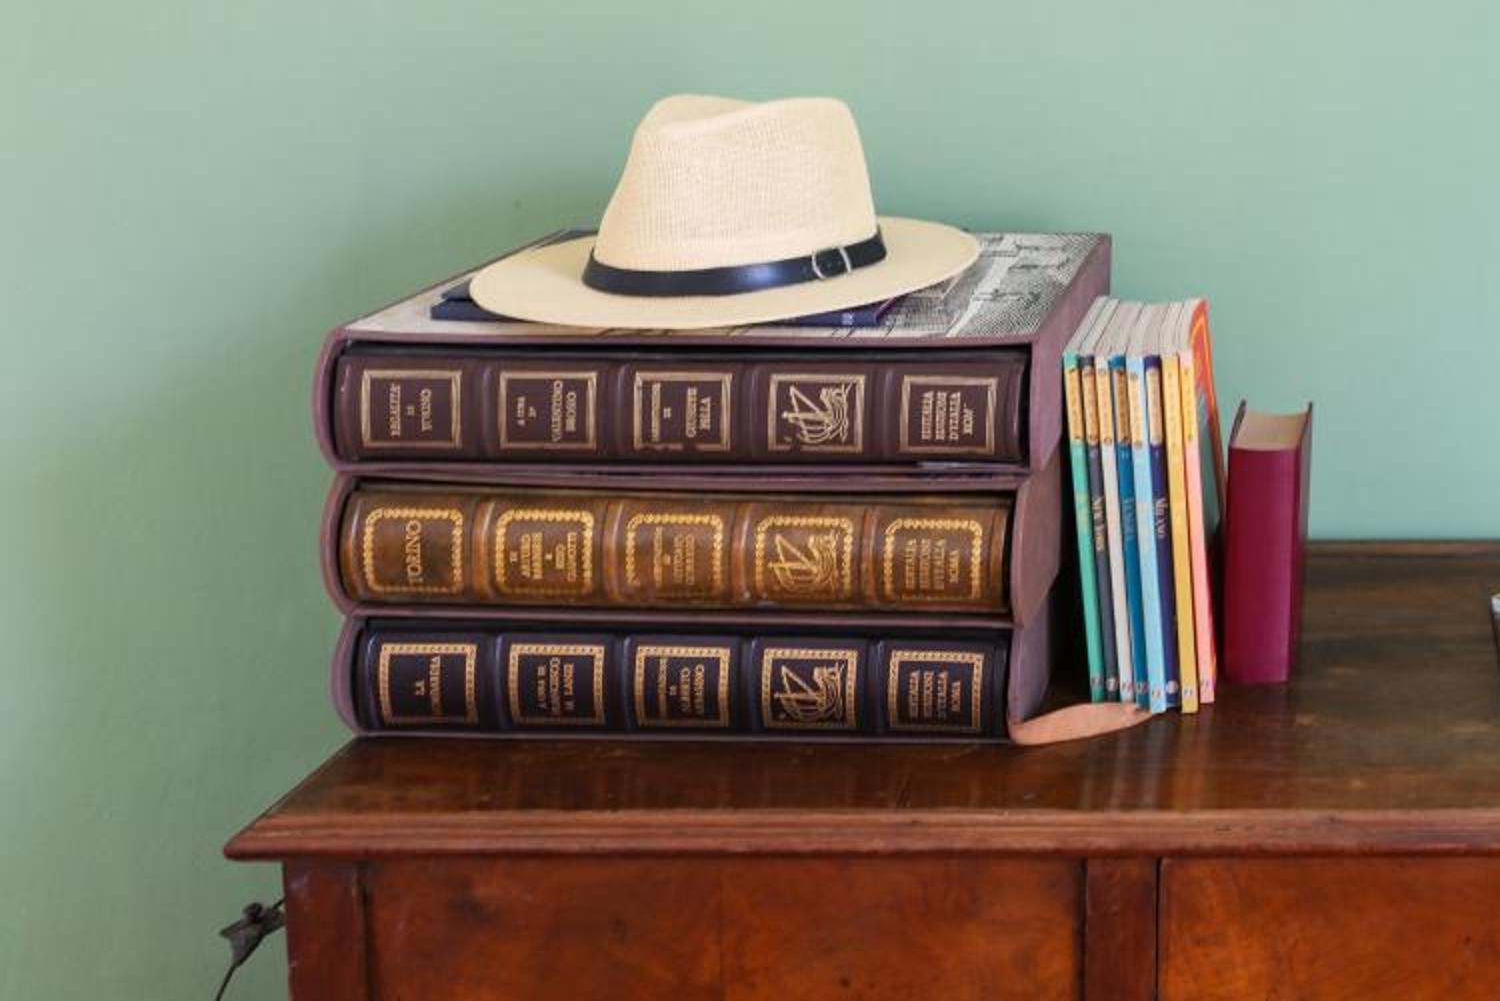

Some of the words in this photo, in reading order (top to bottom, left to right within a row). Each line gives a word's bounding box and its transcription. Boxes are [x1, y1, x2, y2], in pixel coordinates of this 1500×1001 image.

[550, 380, 564, 442] VALENTINO
[405, 519, 422, 585] TORINO
[413, 680, 425, 696] LA
